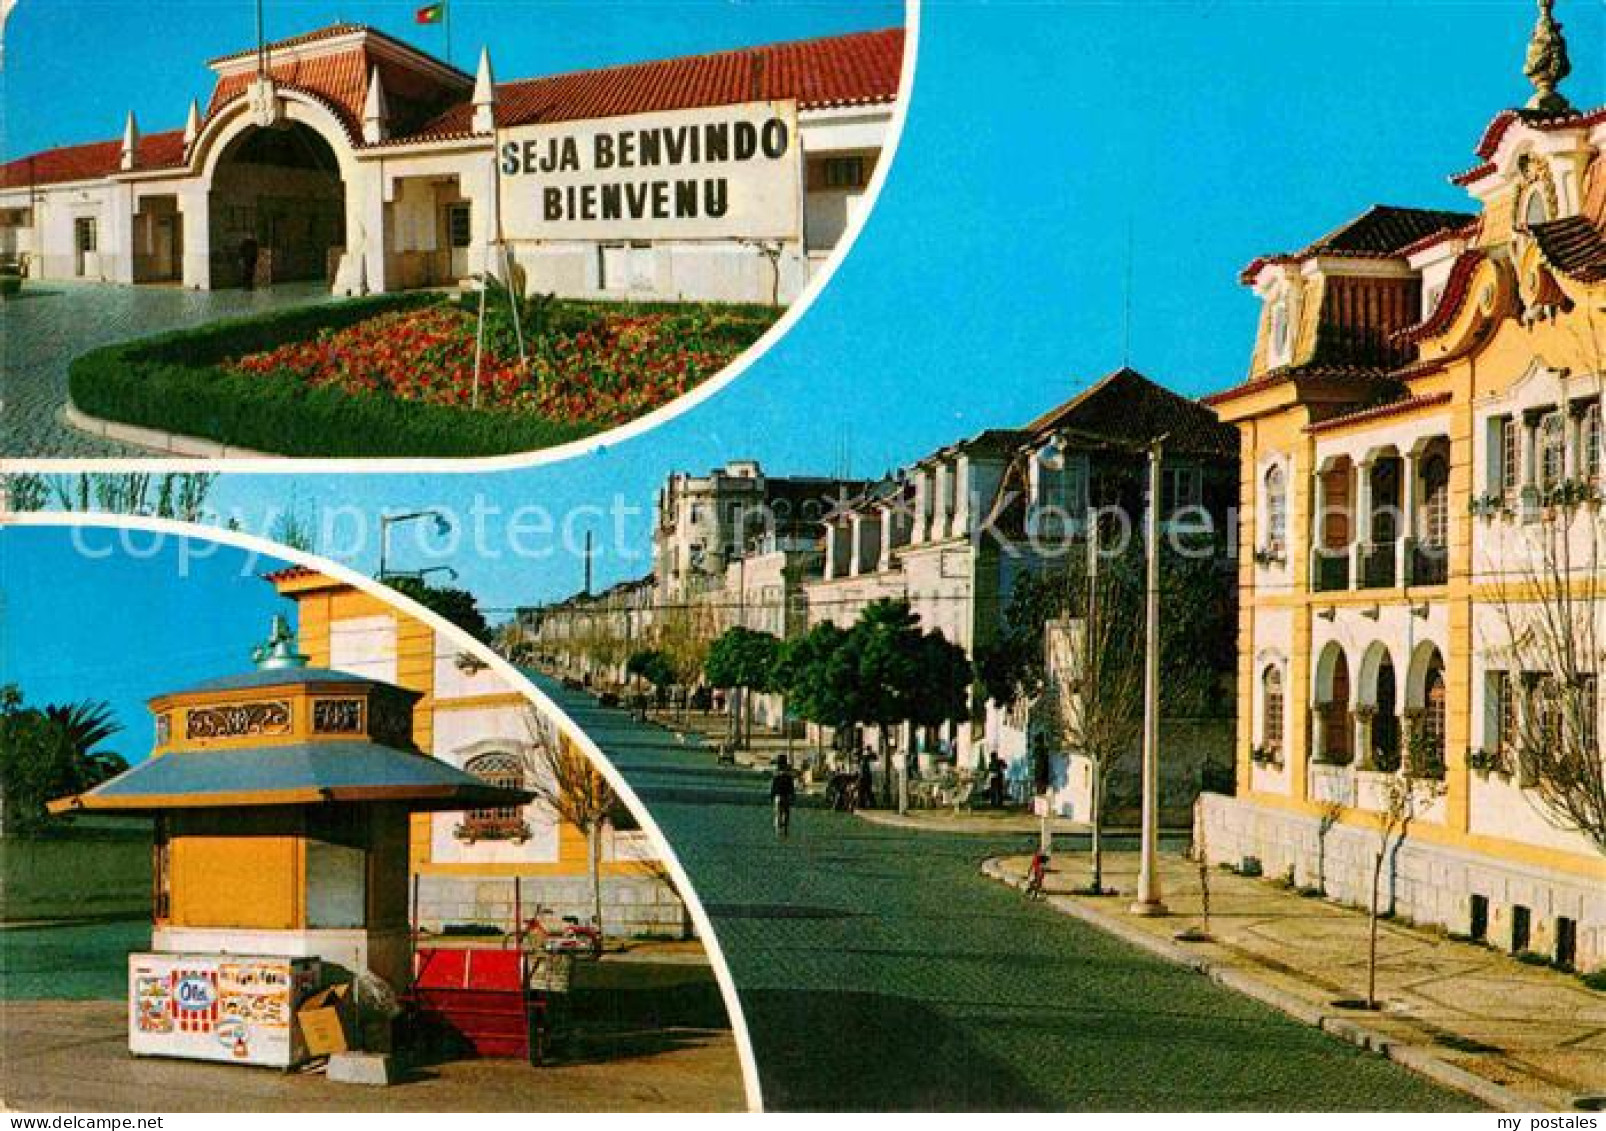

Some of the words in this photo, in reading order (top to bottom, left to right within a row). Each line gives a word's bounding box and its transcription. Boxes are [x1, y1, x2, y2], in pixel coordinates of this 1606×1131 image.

[501, 136, 580, 175] SEJA
[594, 117, 789, 170] BENVINDO
[543, 177, 729, 221] BIENVENU
